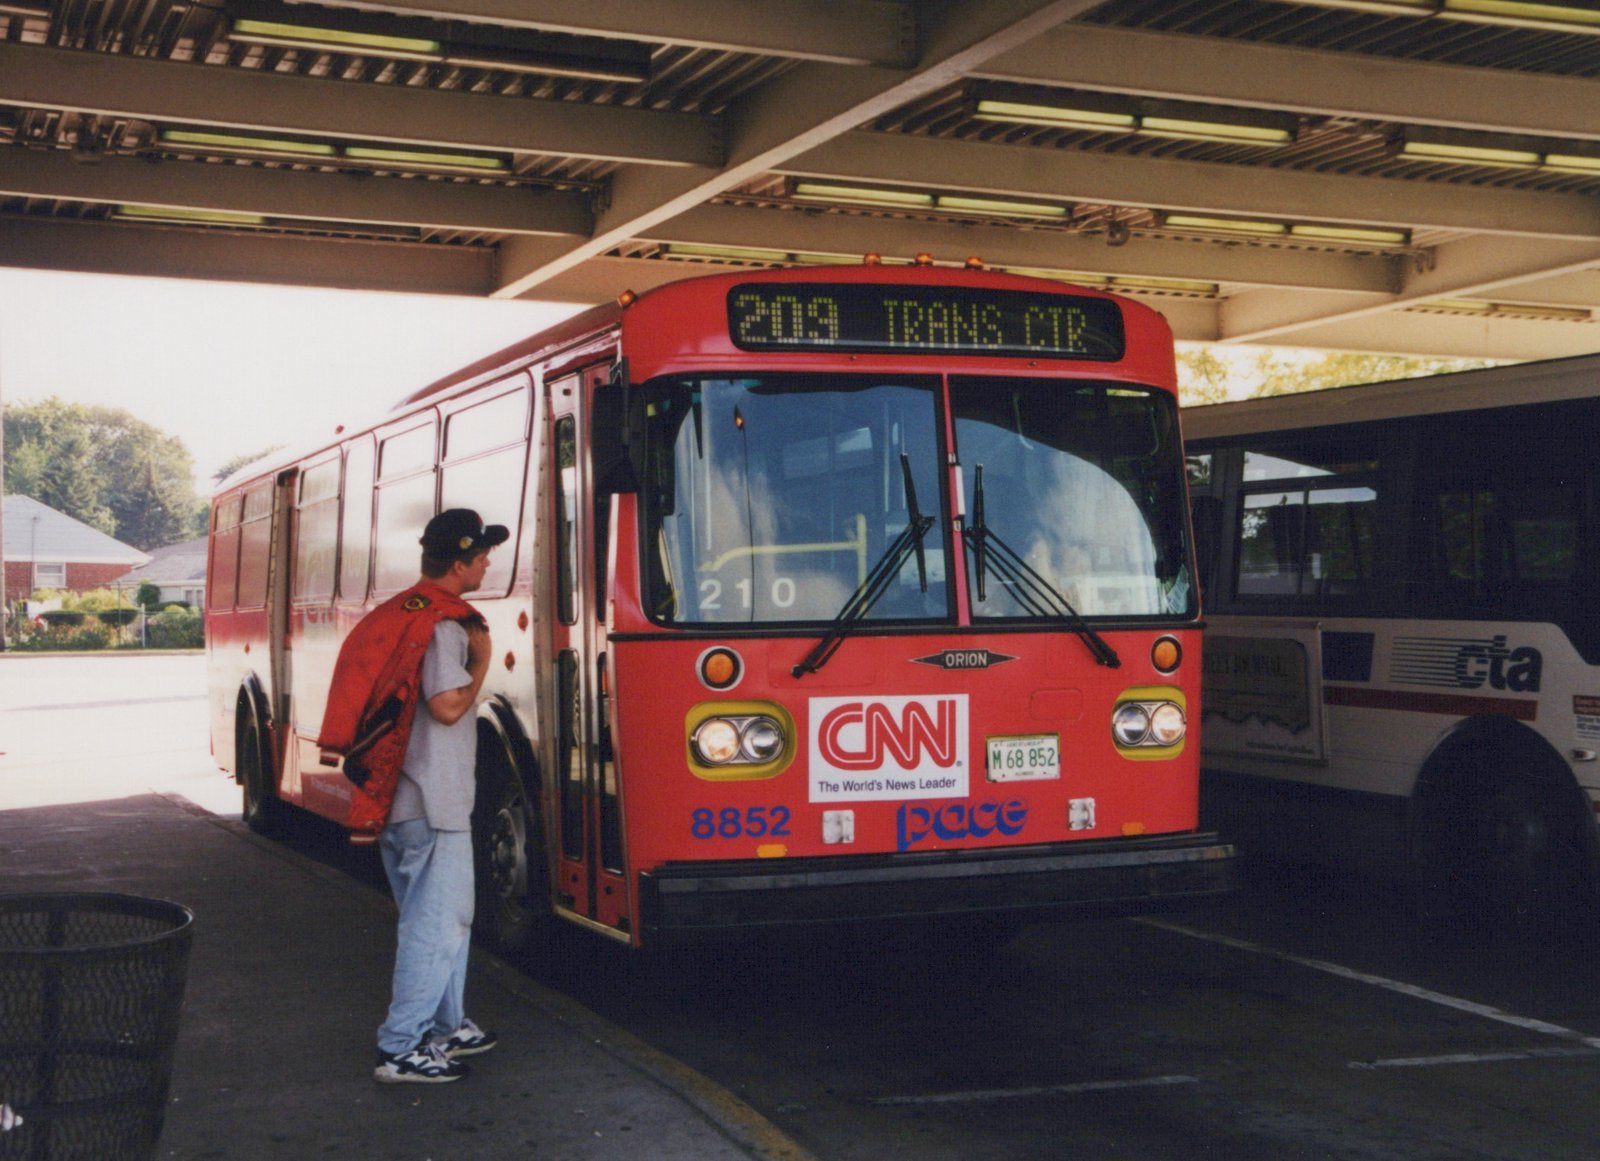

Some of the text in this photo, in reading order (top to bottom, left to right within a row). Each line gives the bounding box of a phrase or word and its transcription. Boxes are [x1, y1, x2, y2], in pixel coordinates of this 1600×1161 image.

[735, 295, 1087, 352] 209 TRANS CTR
[945, 652, 988, 668] ORION
[1455, 635, 1543, 692] cta
[818, 700, 957, 771] CNN
[992, 747, 1056, 770] M 68 852
[818, 777, 957, 793] The World's News Leader
[692, 805, 791, 840] 8852
[896, 798, 1028, 852] pace
